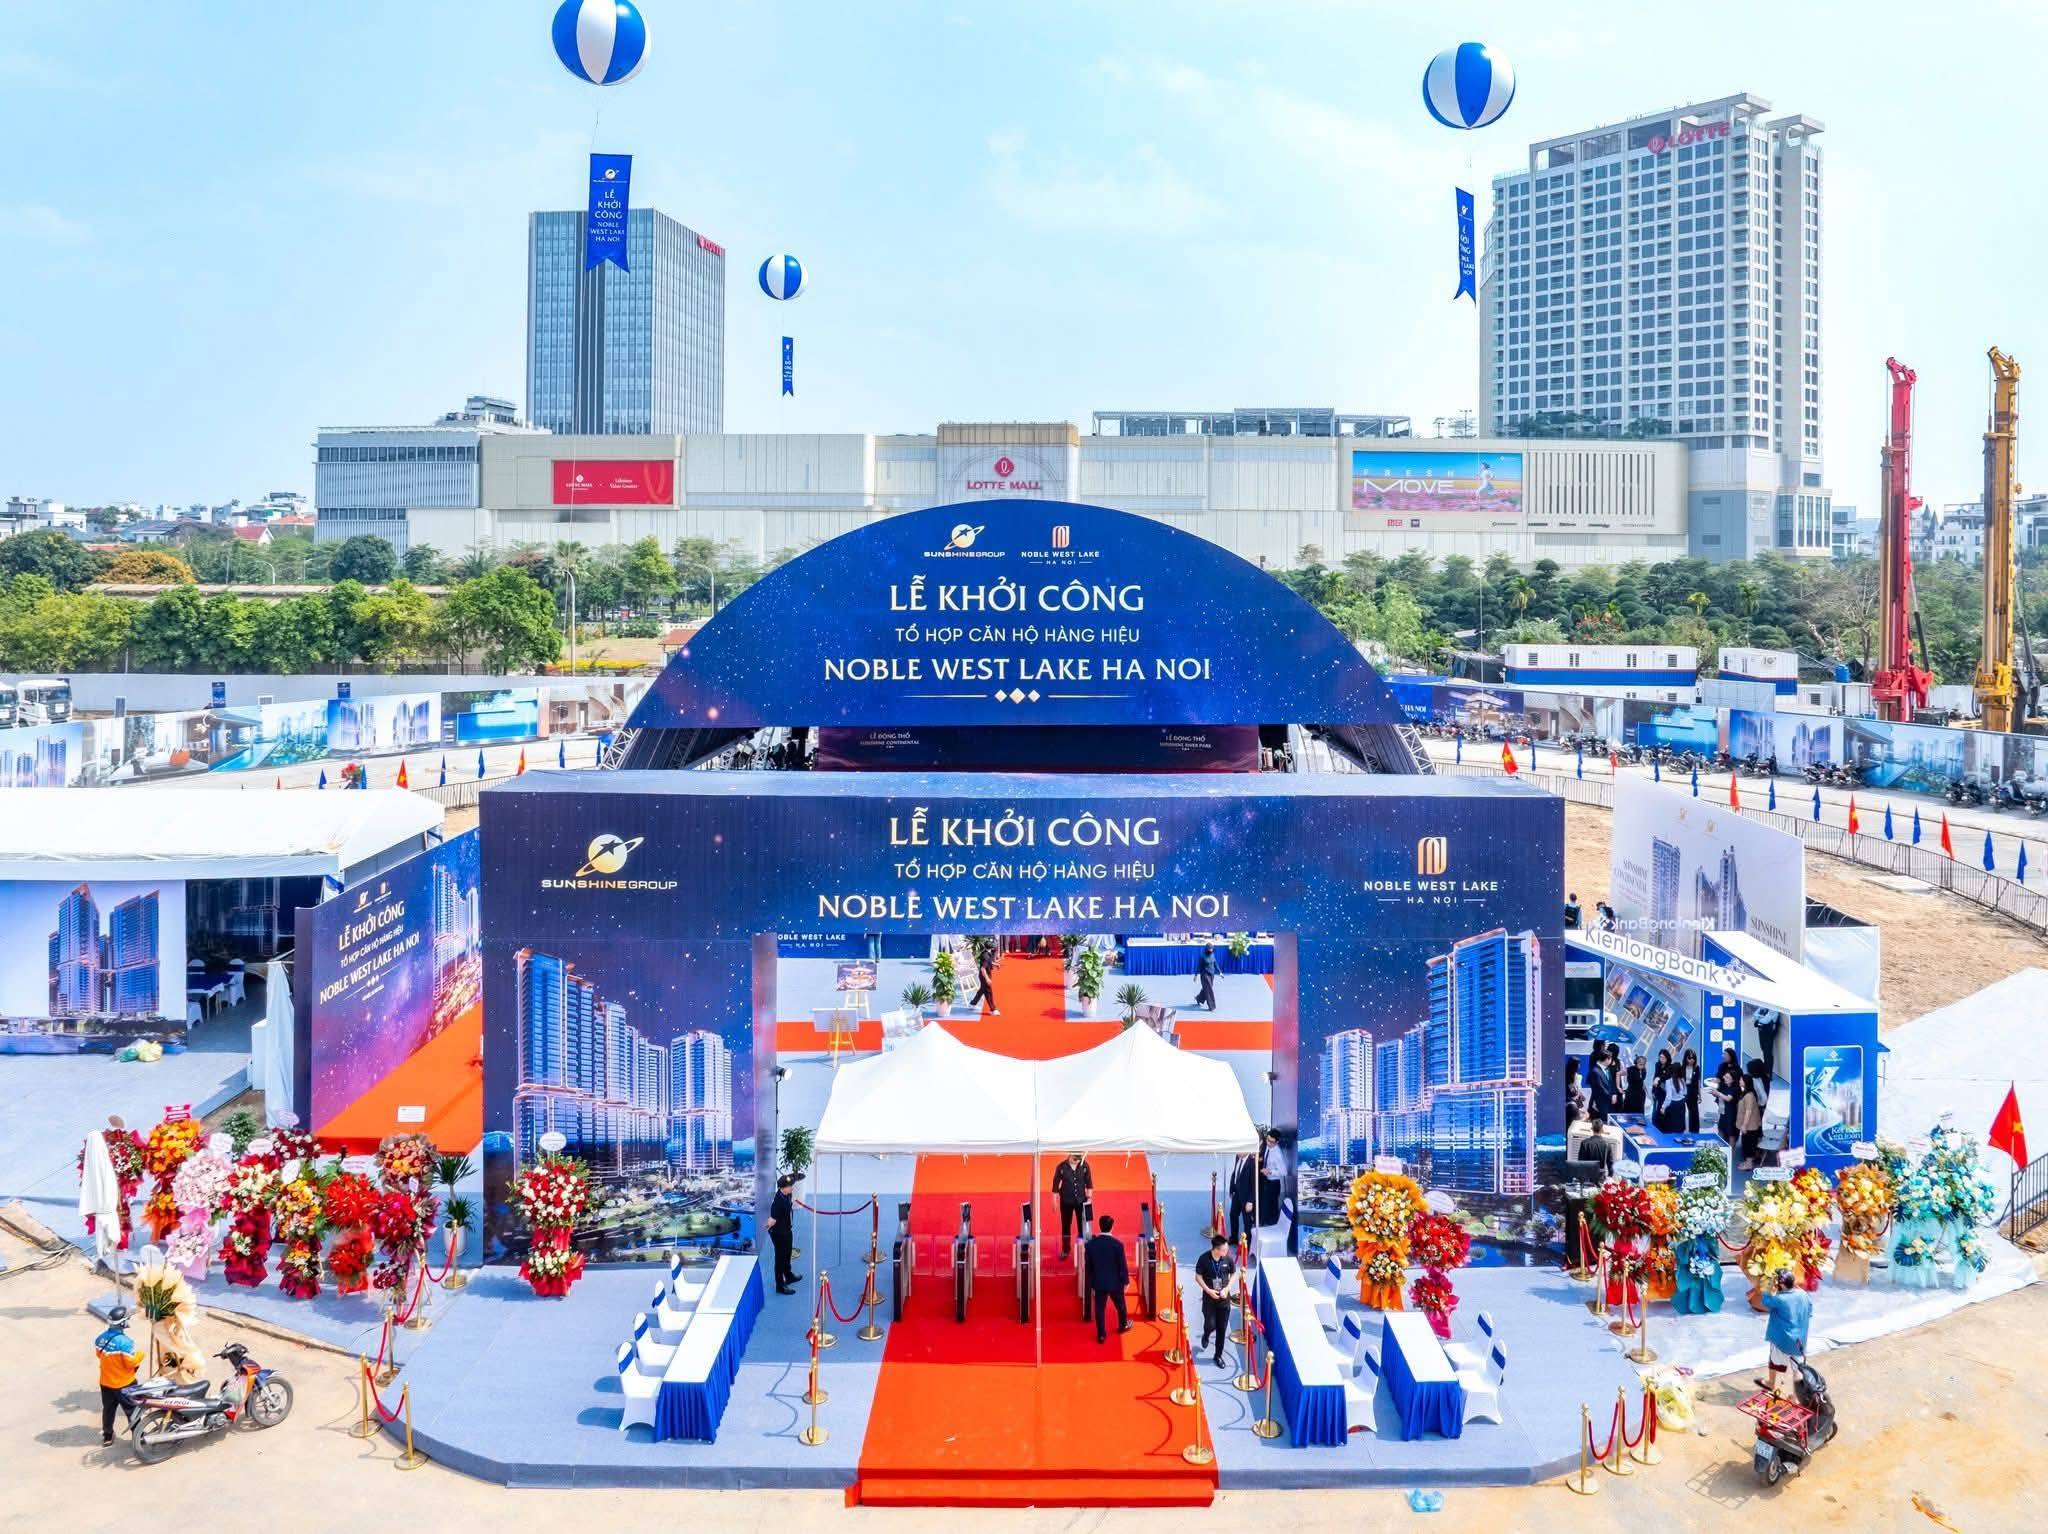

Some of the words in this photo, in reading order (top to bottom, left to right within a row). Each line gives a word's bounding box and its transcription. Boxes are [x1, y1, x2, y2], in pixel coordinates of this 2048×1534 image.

[594, 210, 623, 219] CÔNG
[967, 480, 1005, 490] LOTTE
[1009, 480, 1042, 490] MALL
[1363, 479, 1455, 494] MOVE
[890, 574, 928, 611] LỄ
[938, 575, 1027, 612] KHỞI
[1038, 579, 1144, 612] CÔNG
[895, 623, 920, 643] TỔ
[925, 627, 963, 645] HỢP
[968, 625, 1006, 643] CĂN
[1012, 625, 1039, 645] HỘ
[1044, 625, 1095, 643] HÀNG
[1101, 626, 1141, 646] HIỆU
[824, 658, 923, 681] NOBLE
[931, 658, 1010, 681] WEST
[1019, 658, 1093, 681] LAKE
[1102, 658, 1146, 681] HA
[1155, 657, 1211, 681] NOI
[890, 807, 929, 846] LỄ
[942, 808, 1035, 847] KHỞI
[1047, 811, 1160, 847] CÔNG
[894, 857, 921, 879] TỔ
[927, 863, 967, 881] HỢP
[972, 862, 1012, 879] CĂN
[1019, 861, 1048, 882] HỘ
[1053, 861, 1107, 879] HÀNG
[1114, 861, 1155, 881] HIỆU
[541, 879, 678, 890] SUNSHINEGROUP
[1364, 881, 1411, 891] NOBLE
[1417, 881, 1457, 891] WEST
[1462, 881, 1498, 891] LAKE
[818, 895, 923, 919] NOBLE
[932, 896, 1016, 920] WEST
[1026, 896, 1104, 920] LAKE
[1114, 896, 1161, 919] HA
[1171, 894, 1230, 919] NOI
[1407, 896, 1424, 904] HA
[1433, 896, 1458, 904] NOI
[352, 913, 377, 943] KHỞI
[378, 901, 405, 928] CÔNG
[1585, 924, 1719, 984] KienlongBank
[320, 975, 349, 1005] NOBLE
[350, 961, 372, 985] WEST
[373, 949, 393, 971] LAKE
[393, 941, 405, 958] HA
[406, 931, 420, 951] NOI
